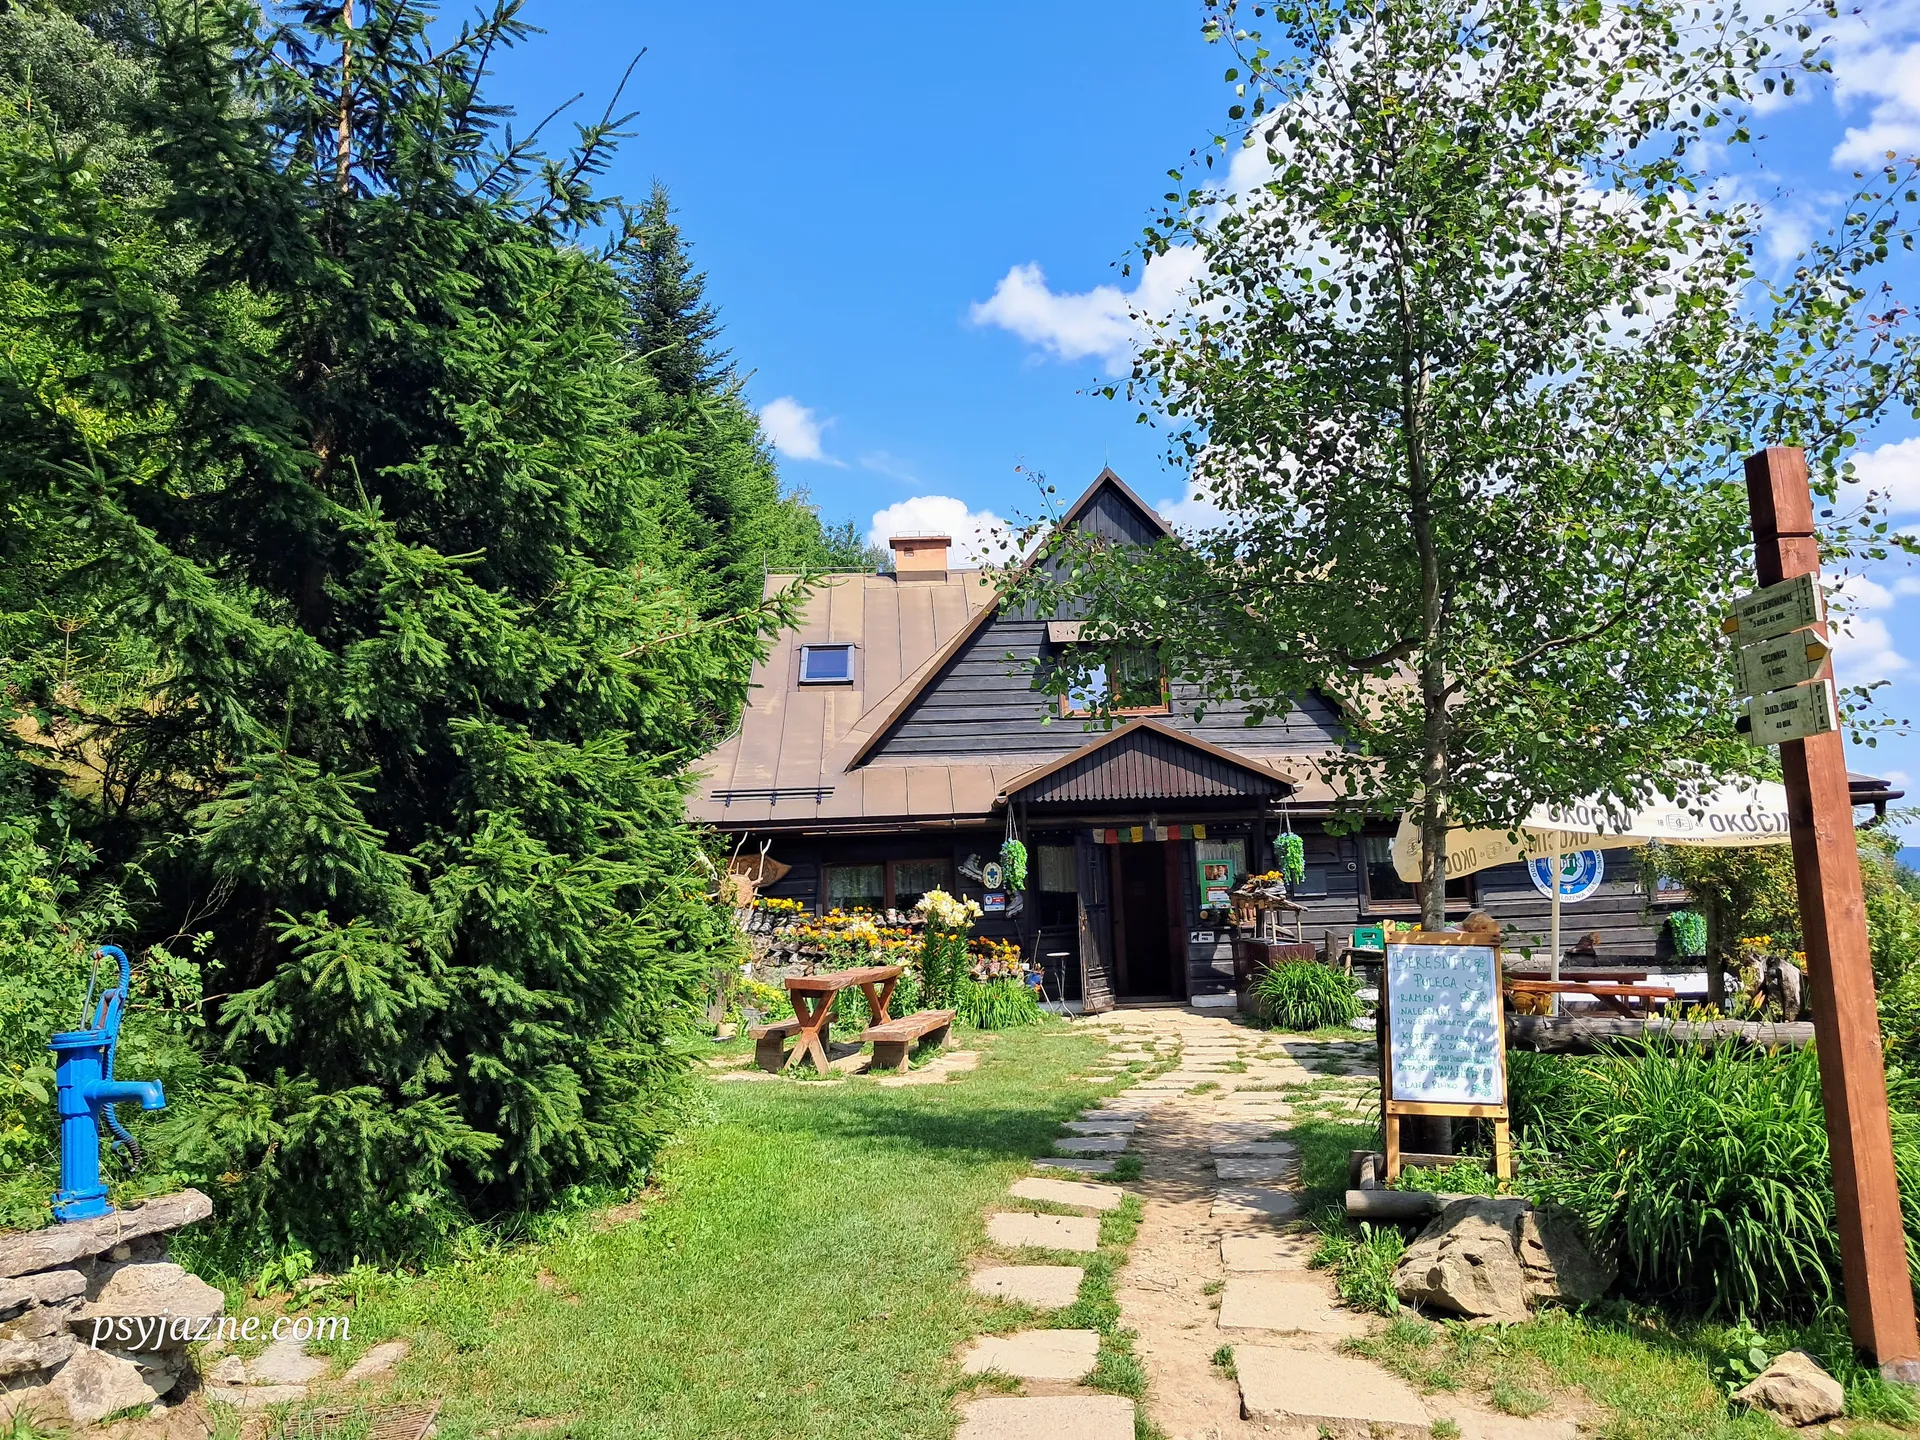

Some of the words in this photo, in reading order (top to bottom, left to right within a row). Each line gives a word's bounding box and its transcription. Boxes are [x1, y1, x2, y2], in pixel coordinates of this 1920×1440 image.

[1802, 577, 1811, 616] PTTK
[1815, 684, 1826, 725] PTTK
[1393, 952, 1471, 972] BEREŚNIK
[1414, 973, 1458, 989] POLECA
[1400, 993, 1434, 1003] RAMEN
[1465, 1010, 1491, 1019] SEREM
[1402, 1031, 1435, 1041] KOTLET
[1404, 1081, 1428, 1089] LANE
